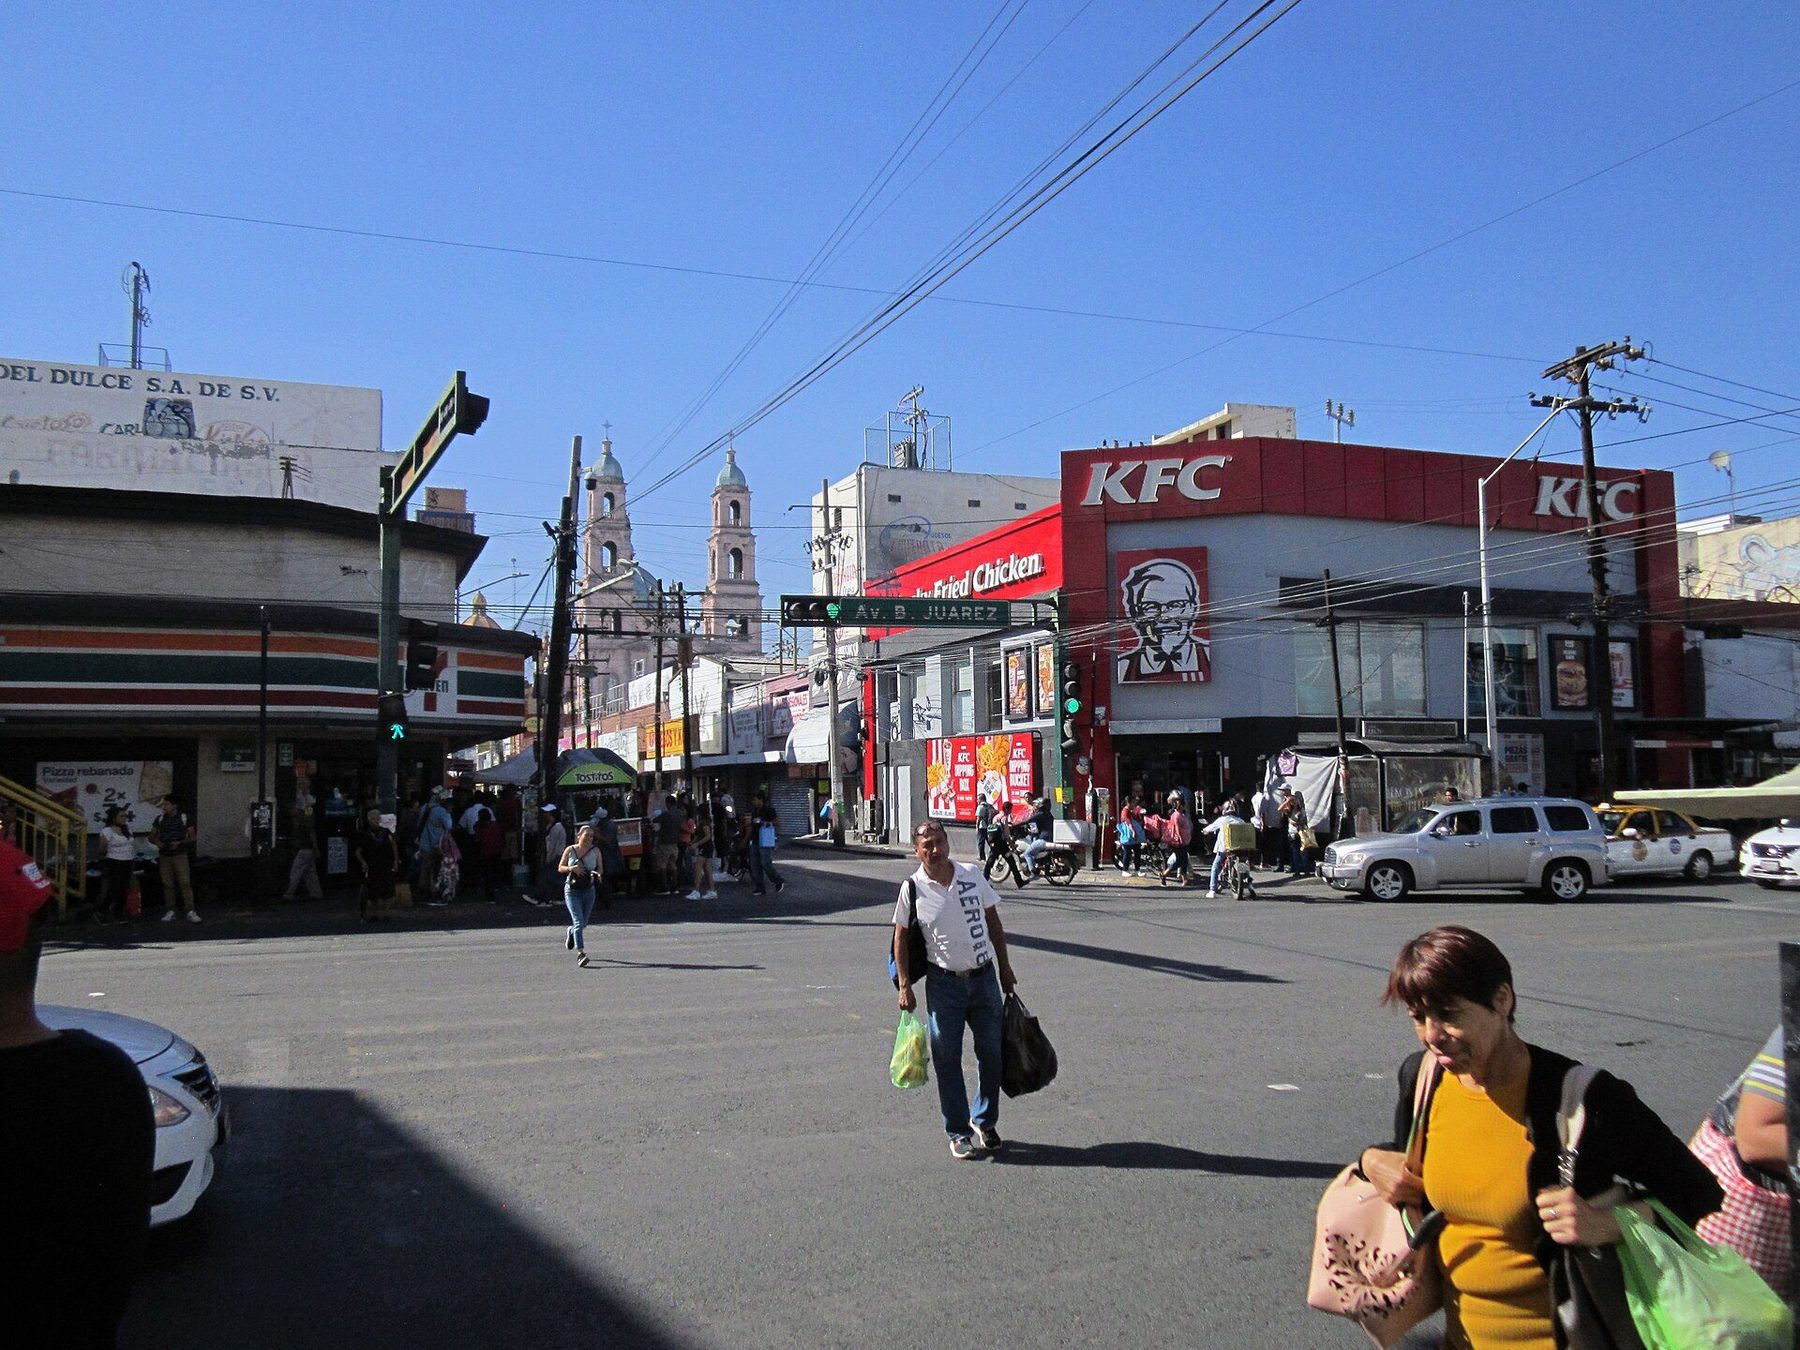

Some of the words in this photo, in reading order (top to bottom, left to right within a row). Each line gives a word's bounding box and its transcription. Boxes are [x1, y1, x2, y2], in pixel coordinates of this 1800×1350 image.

[0, 364, 42, 383] DEL
[50, 368, 133, 390] DULCE
[147, 377, 191, 395] S.A.
[199, 381, 232, 398] DE
[241, 385, 280, 402] S.V.
[1081, 455, 1226, 506] KFC
[1534, 476, 1636, 520] KFC
[933, 569, 971, 600] Fried
[972, 552, 1043, 593] Chicken
[855, 604, 887, 620] Av.
[922, 606, 998, 621] JUAREZ
[957, 752, 970, 763] KFC
[1012, 748, 1026, 759] KFC
[42, 767, 75, 777] Pizza
[77, 766, 134, 777] rebanada
[954, 764, 975, 777] DIPPING
[1009, 760, 1030, 773] DIPPING
[575, 771, 614, 783] TOSTITOS
[1010, 774, 1030, 787] BUCKET
[959, 778, 970, 792] BOX
